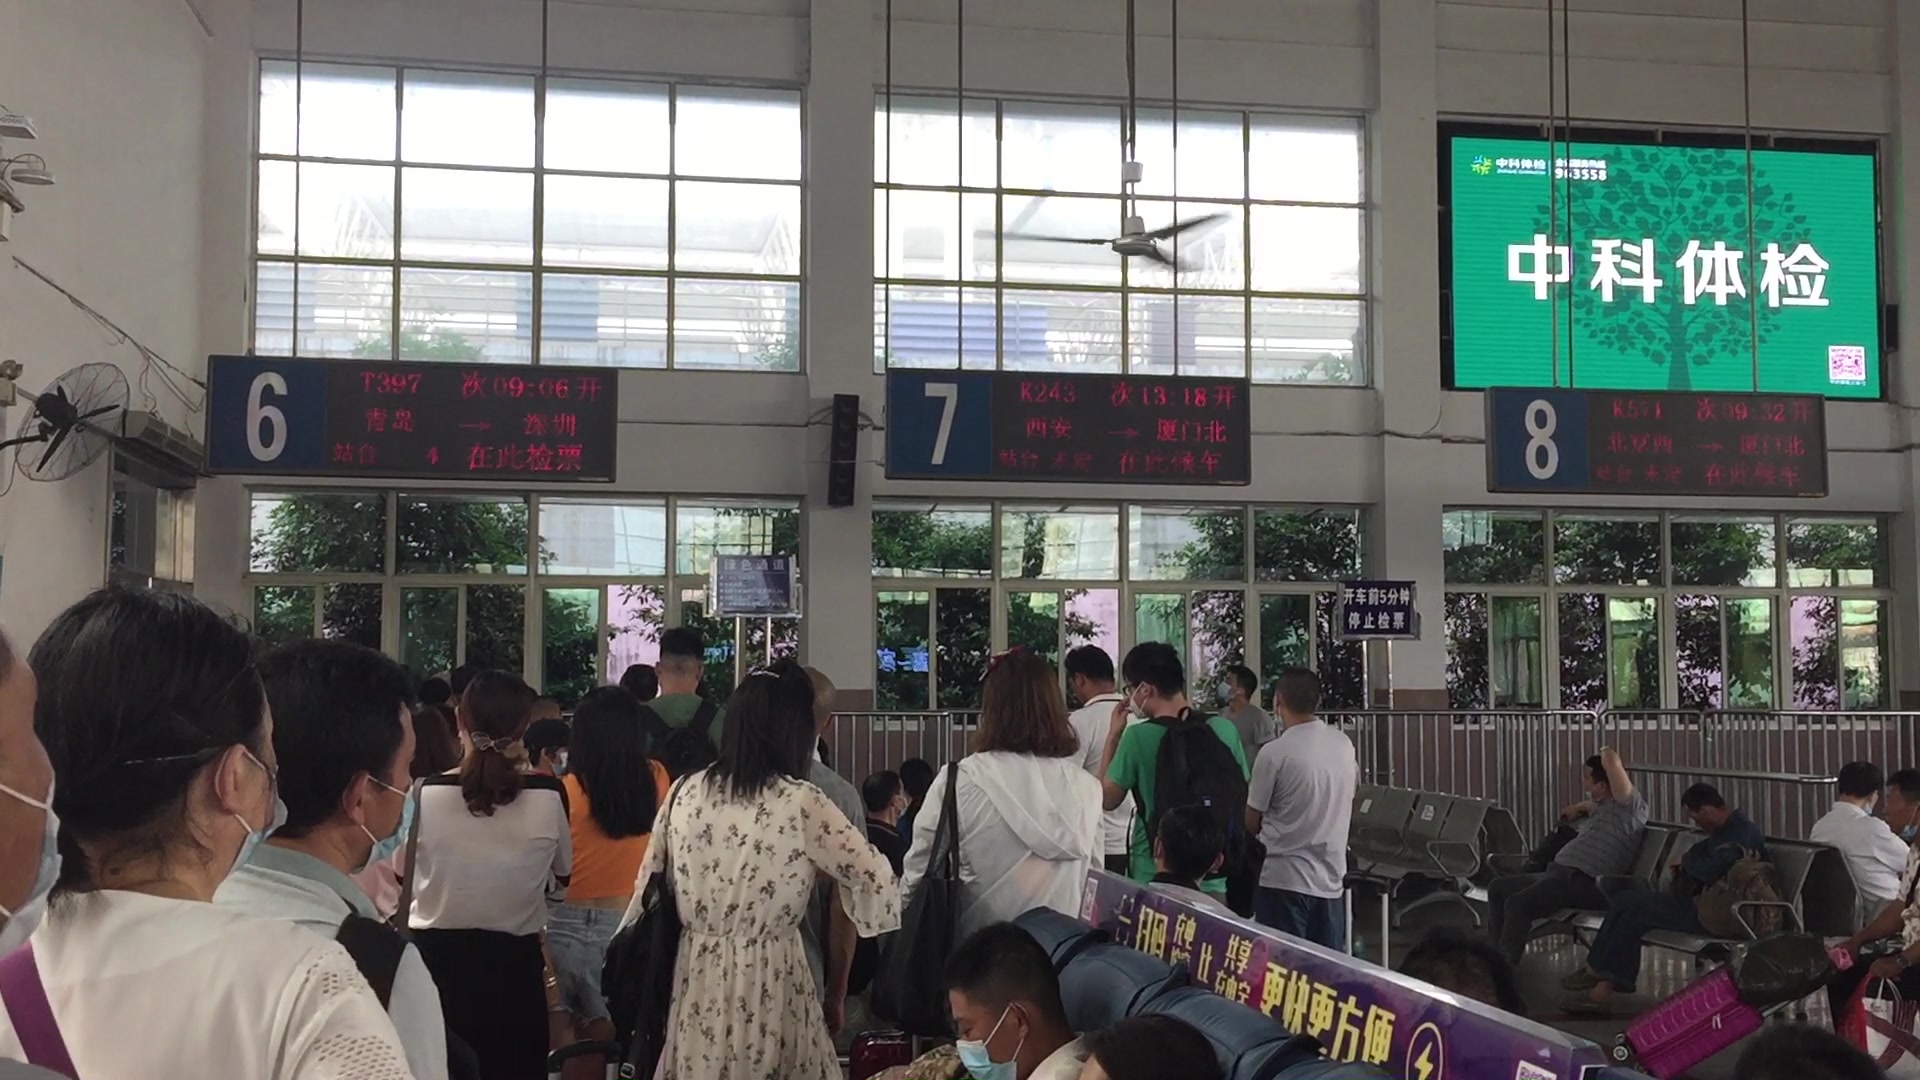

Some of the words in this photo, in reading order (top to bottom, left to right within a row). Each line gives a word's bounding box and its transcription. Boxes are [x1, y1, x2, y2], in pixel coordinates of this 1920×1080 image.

[1496, 157, 1546, 170] 中科体检
[1507, 233, 1830, 308] 中科体检
[361, 371, 423, 394] T397
[1020, 381, 1077, 404] K243
[246, 371, 288, 462] 6
[365, 407, 415, 432] 青岛
[523, 412, 578, 437] 深圳
[924, 382, 958, 466] 7
[1026, 416, 1072, 440] 西安
[1156, 418, 1228, 444] 厦门北
[333, 442, 378, 465] 站台
[467, 442, 584, 472] 在此检票
[1524, 399, 1559, 480] 8
[1343, 587, 1410, 606] 开车前5分钟
[1348, 611, 1405, 630] 停止检票
[1135, 904, 1168, 959] 扫码
[1172, 912, 1198, 951] 充电
[1196, 942, 1212, 985] 比
[1223, 933, 1253, 975] 共享
[1214, 969, 1252, 1005] 充电宝
[1259, 961, 1396, 1066] 更快更方便
